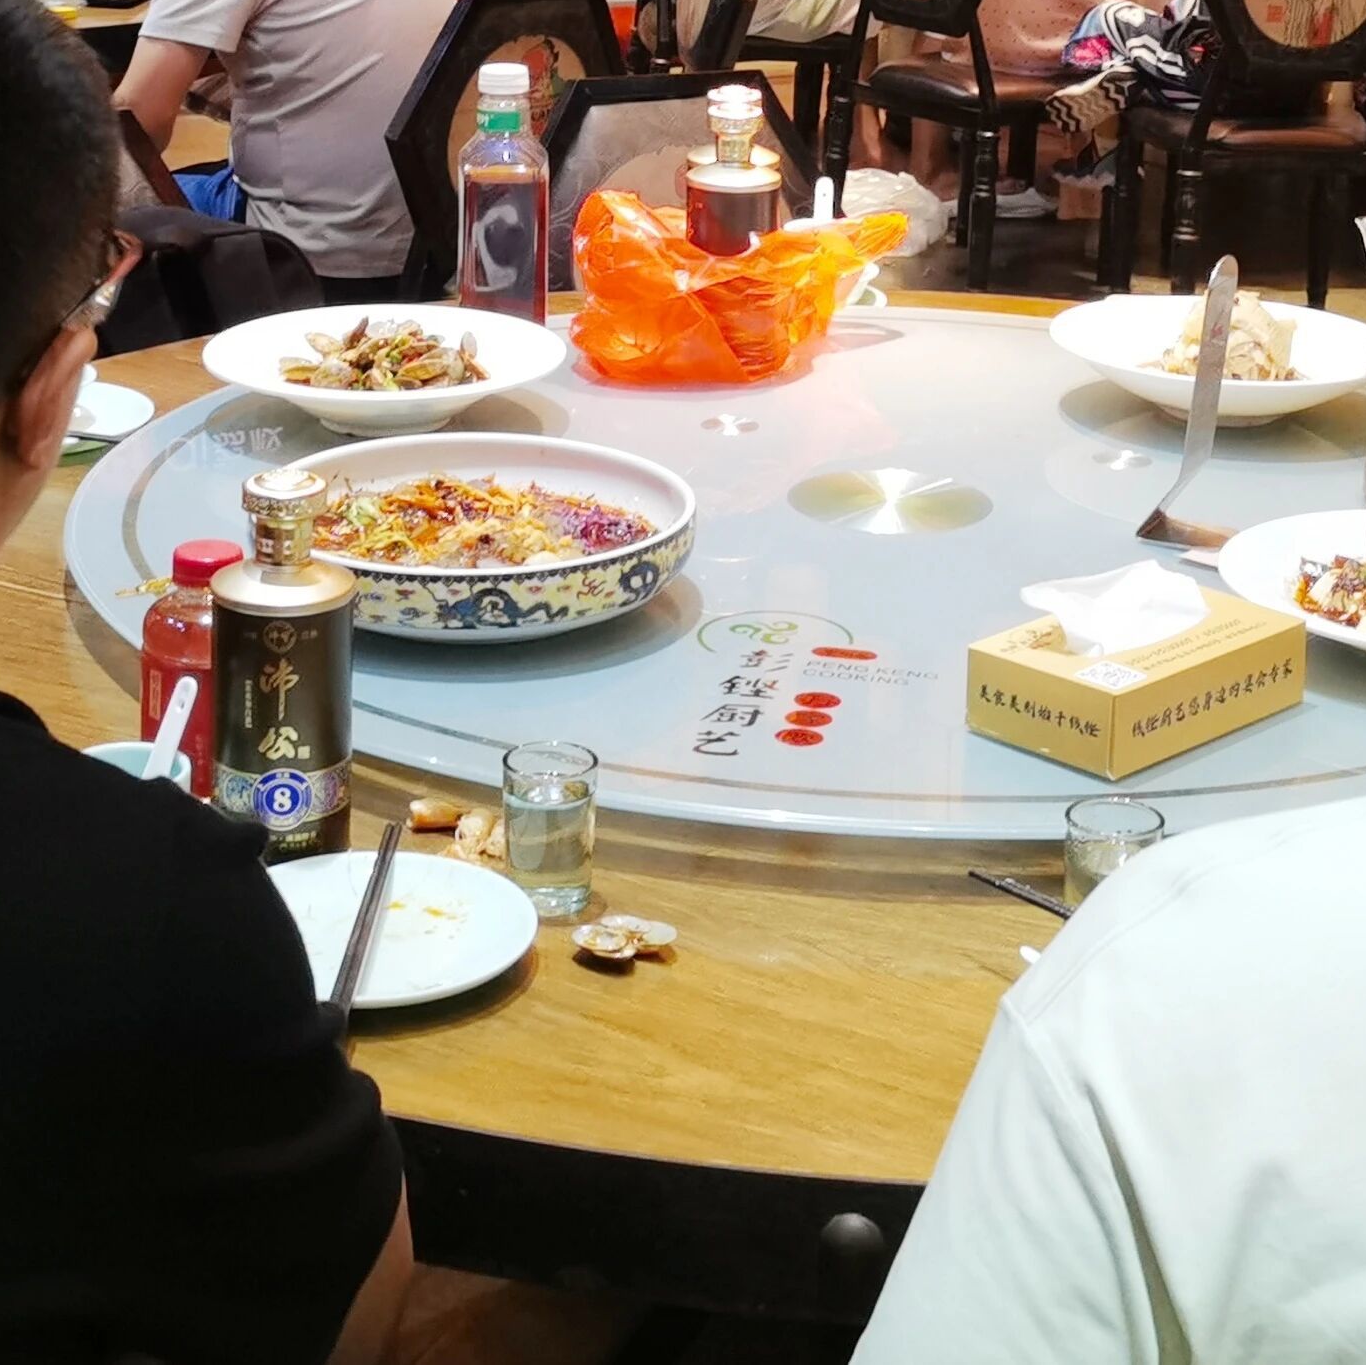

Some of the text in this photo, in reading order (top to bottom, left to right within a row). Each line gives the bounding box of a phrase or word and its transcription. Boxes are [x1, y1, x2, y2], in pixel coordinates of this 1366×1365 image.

[802, 669, 911, 686] COOKING
[805, 661, 939, 681] PENG KENG
[258, 657, 299, 760] 沛公
[272, 787, 292, 812] 8
